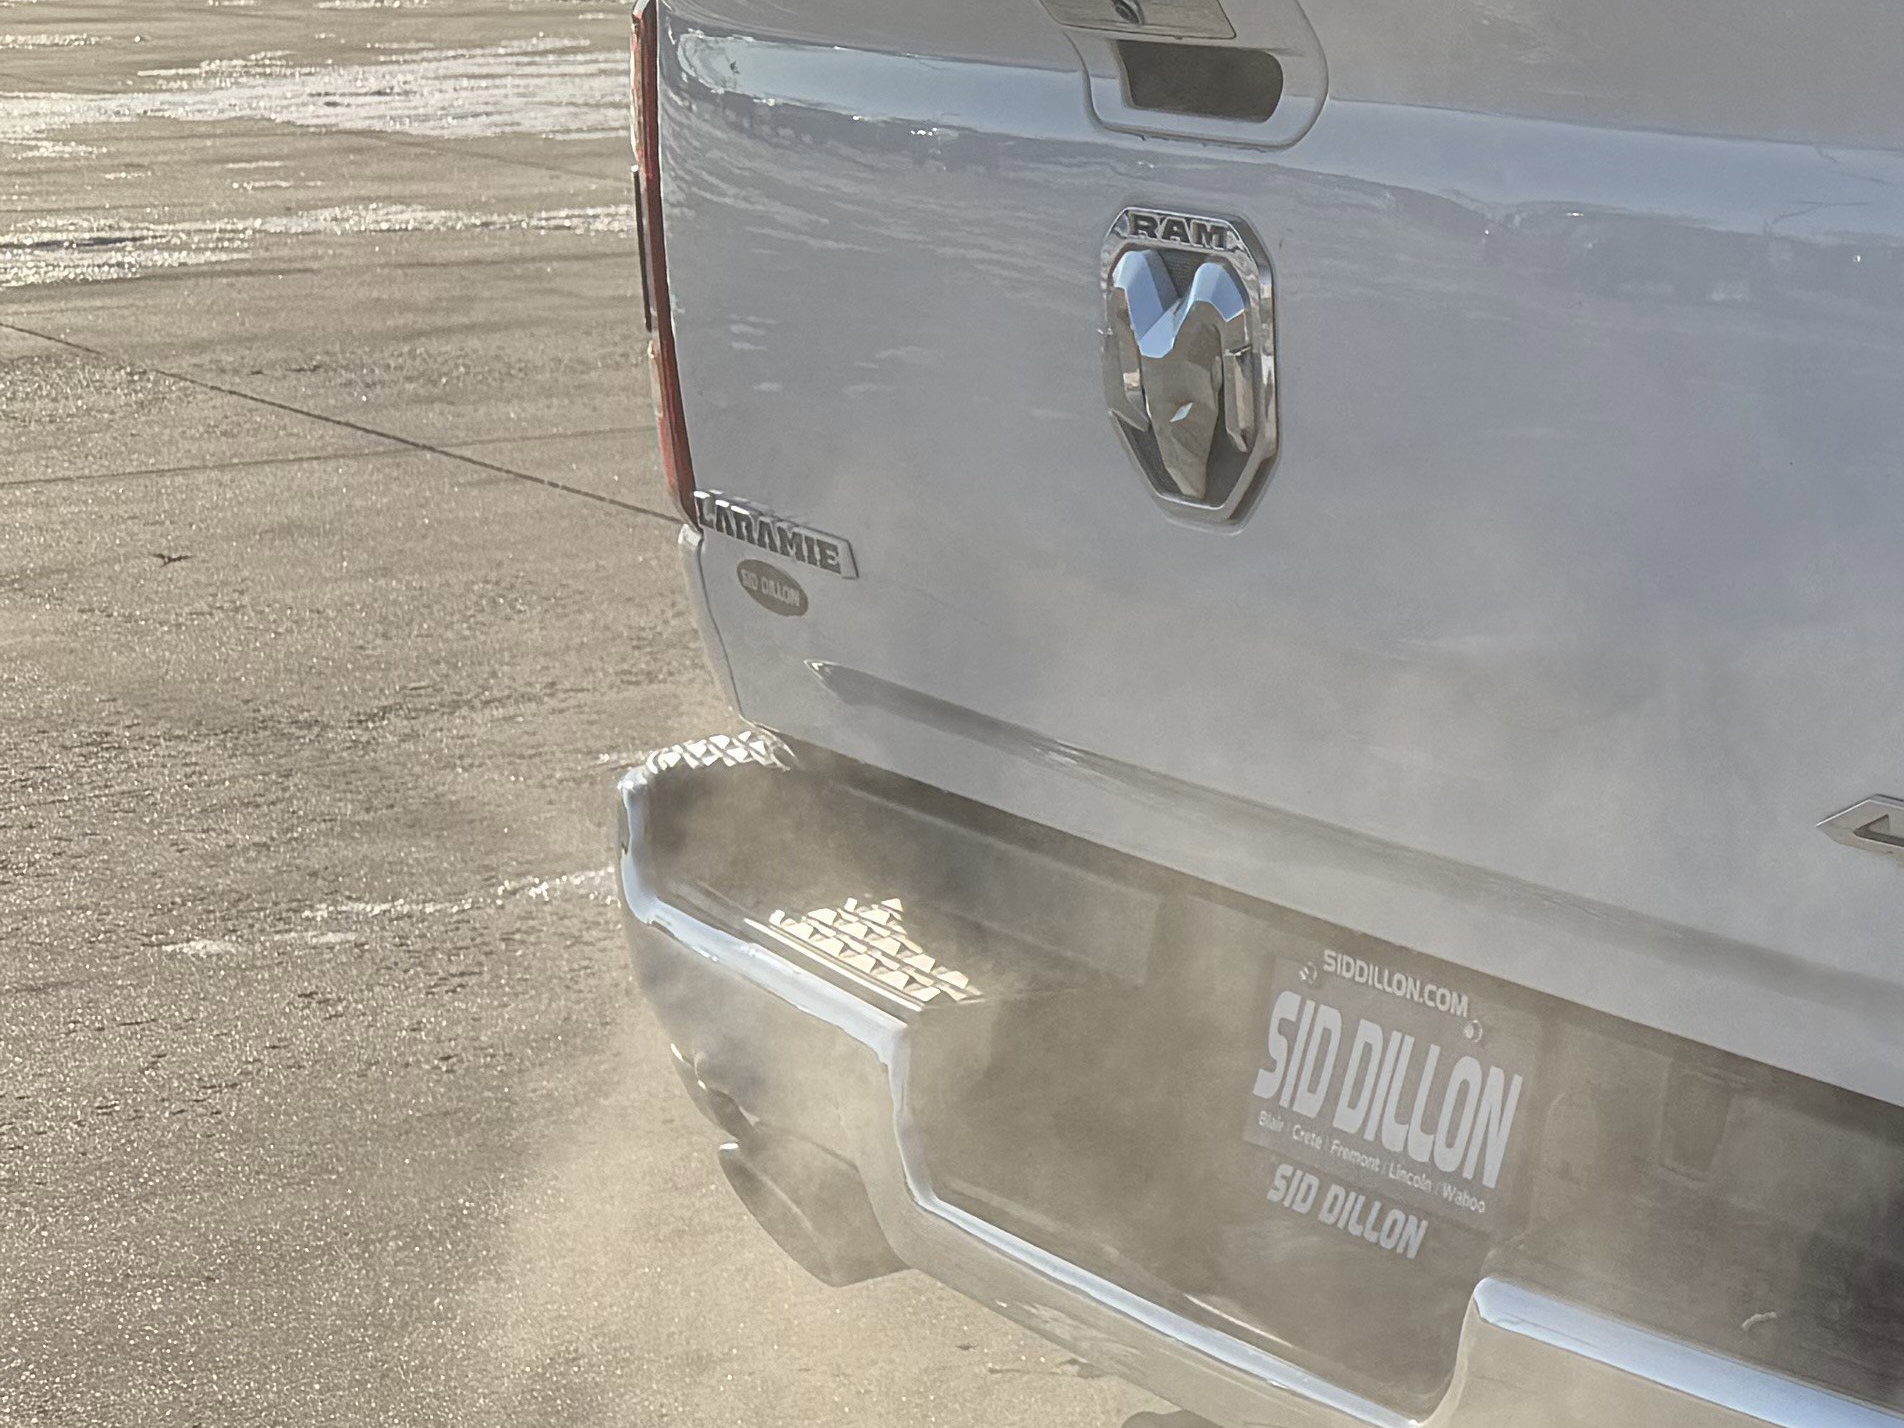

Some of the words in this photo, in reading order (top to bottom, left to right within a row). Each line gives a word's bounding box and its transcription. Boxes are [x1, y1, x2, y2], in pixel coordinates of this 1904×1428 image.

[1127, 214, 1230, 251] RAM
[694, 489, 842, 575] LARAMIE
[1322, 948, 1470, 1018] SIDDILLON.COM
[1252, 990, 1343, 1119] SID
[1332, 1018, 1523, 1190] DILLON
[1291, 1124, 1324, 1150] Crete
[1329, 1139, 1381, 1173] Fremont
[1388, 1162, 1433, 1194] Lincoln
[1266, 1163, 1321, 1214] SID
[1318, 1184, 1429, 1260] DILLON
